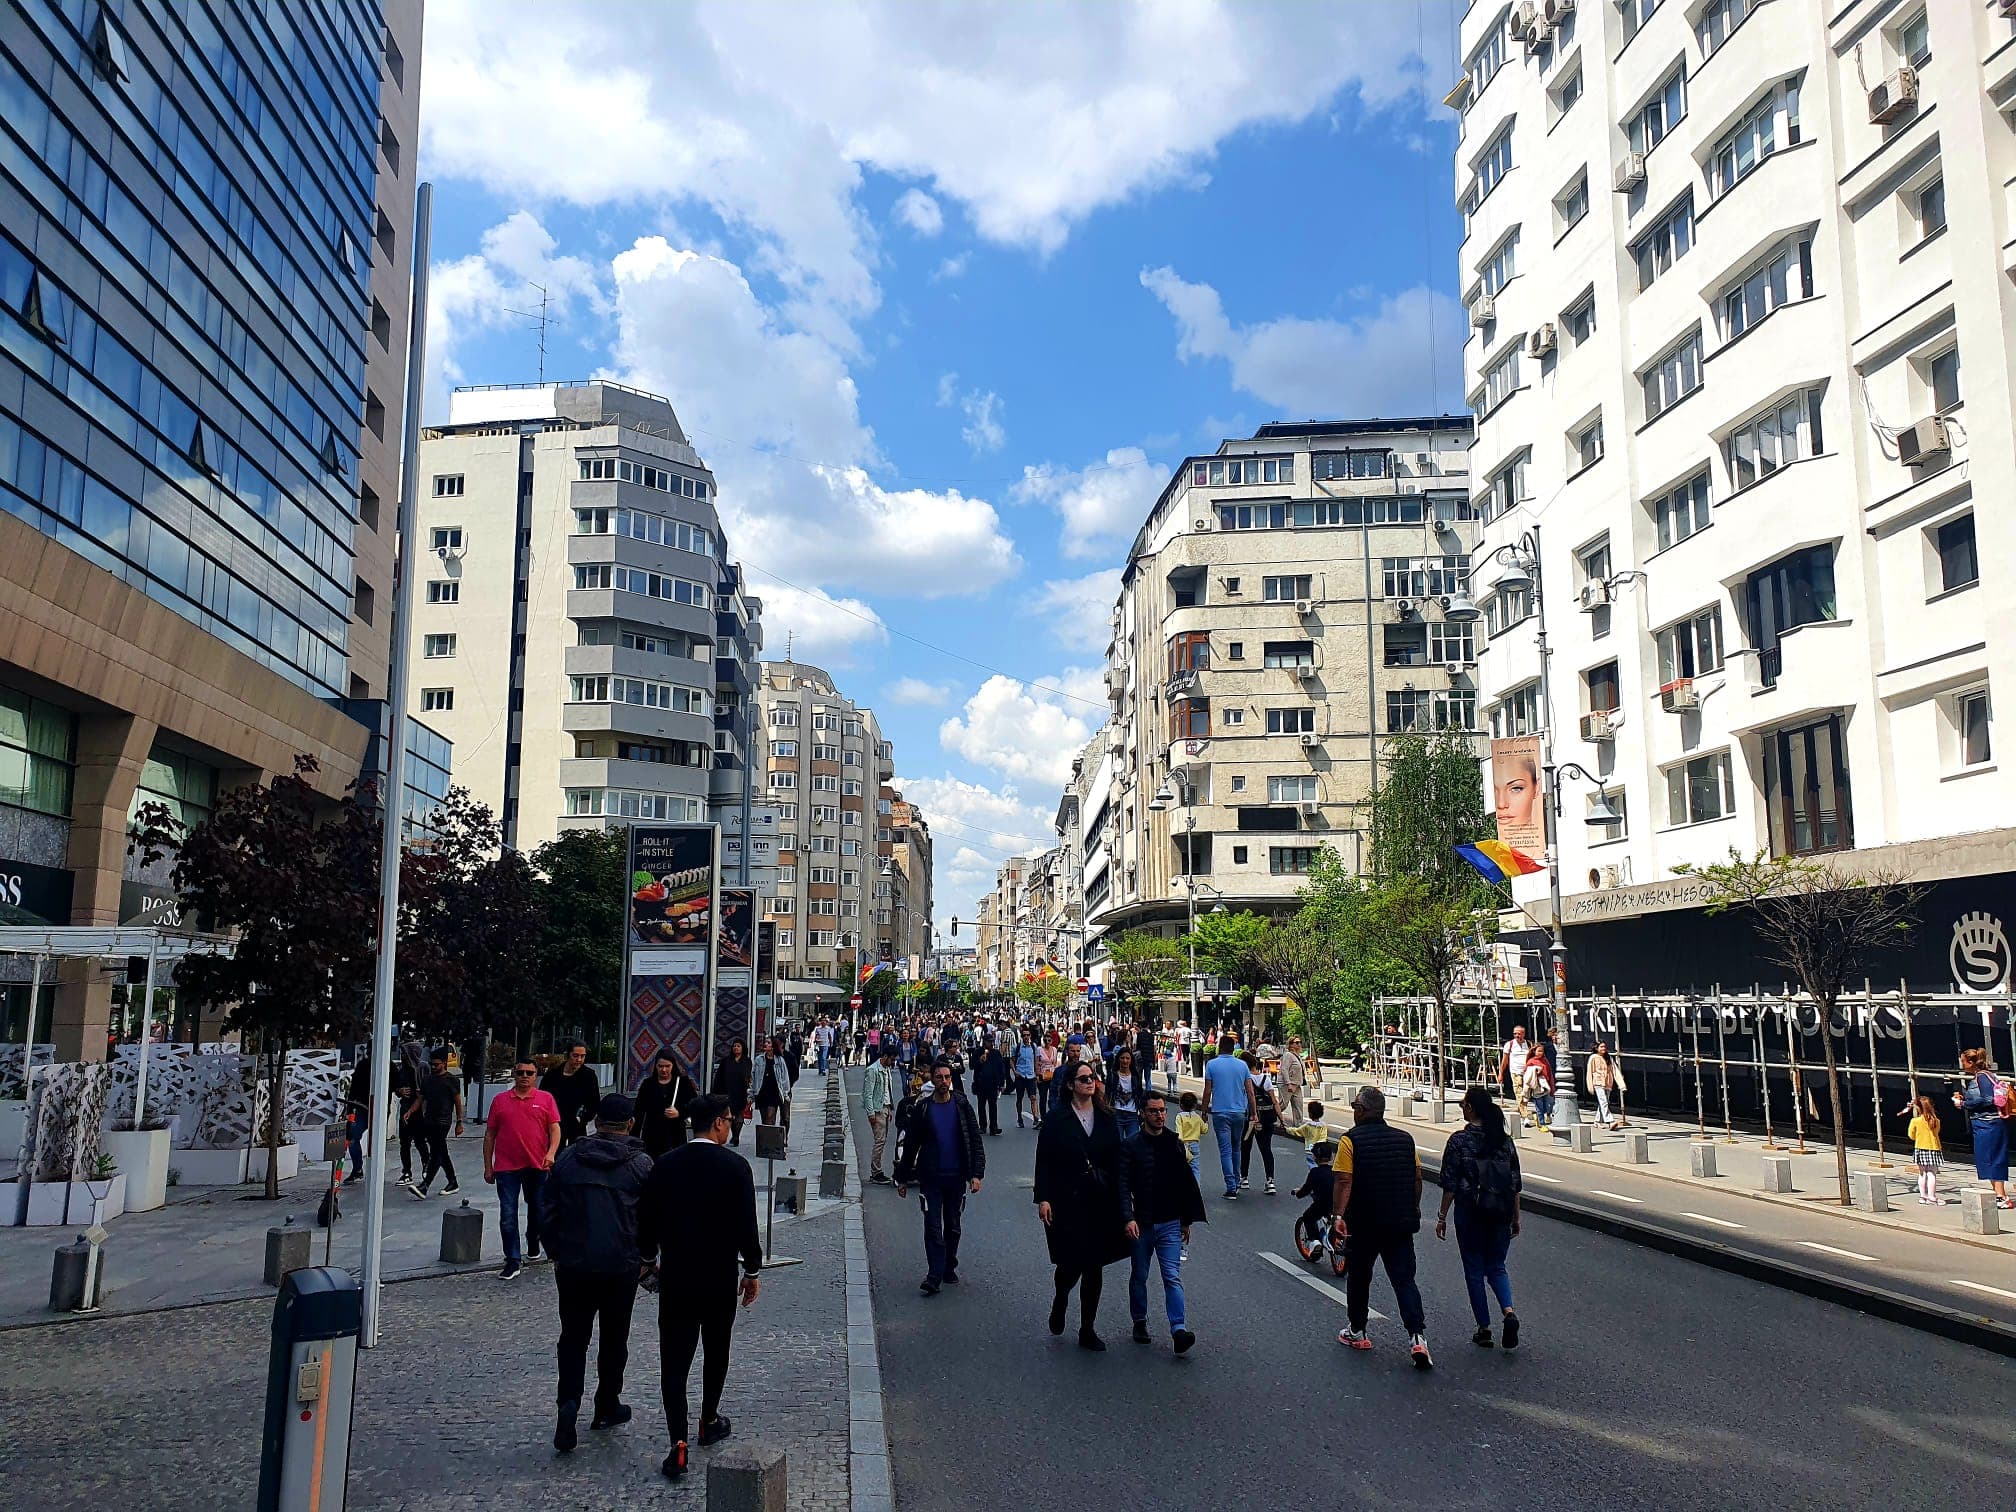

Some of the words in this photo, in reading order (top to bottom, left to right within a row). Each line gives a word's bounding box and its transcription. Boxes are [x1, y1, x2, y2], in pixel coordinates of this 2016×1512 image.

[753, 840, 769, 849] inn
[642, 848, 650, 857] IN
[651, 848, 674, 857] STYLE
